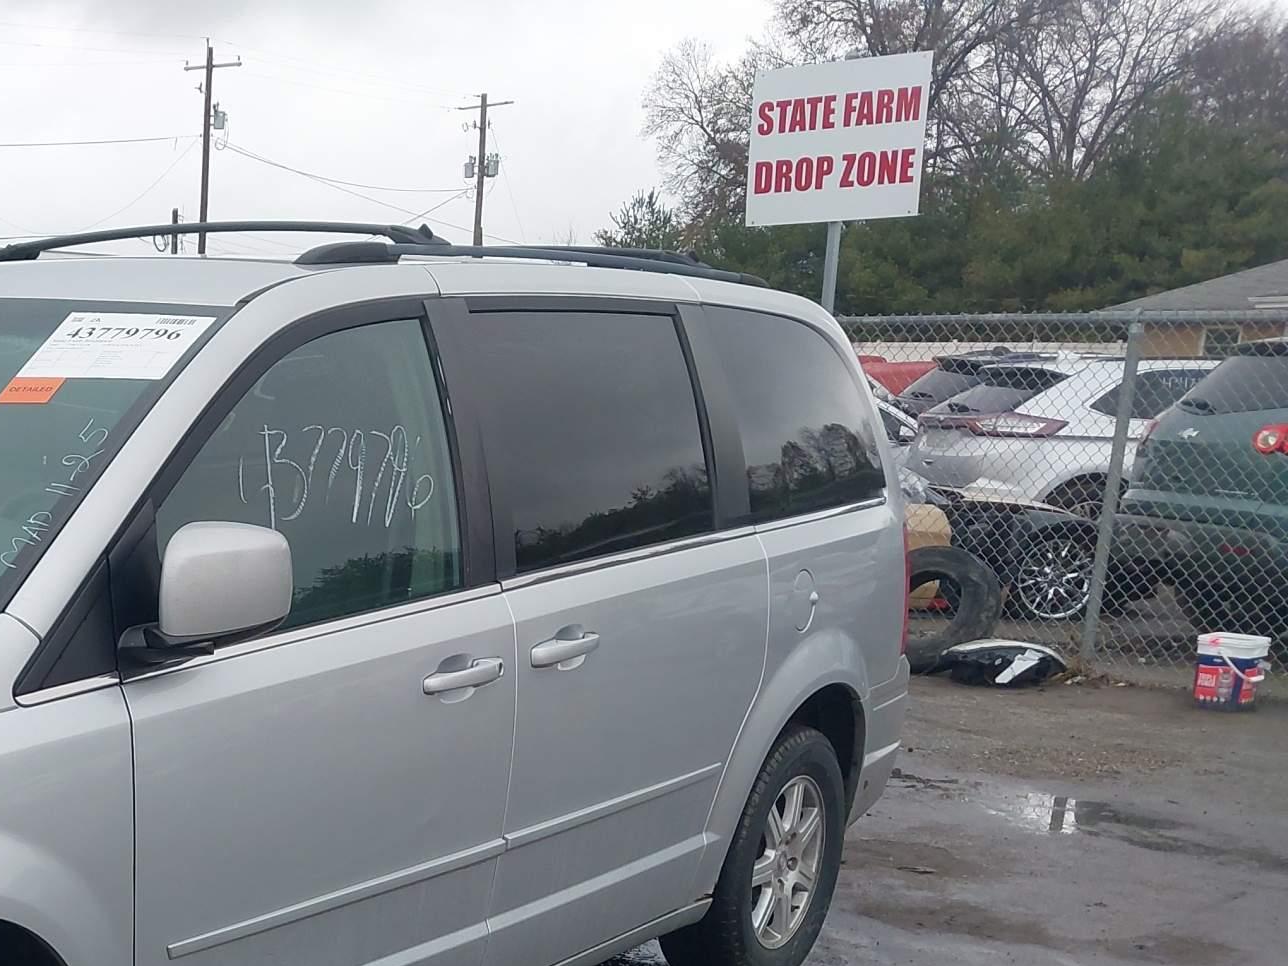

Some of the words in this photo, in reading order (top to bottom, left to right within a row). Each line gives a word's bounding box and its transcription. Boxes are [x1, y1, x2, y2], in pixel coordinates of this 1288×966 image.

[757, 95, 837, 136] STATE
[843, 85, 922, 127] FARM
[754, 156, 834, 195] DROP
[839, 148, 916, 188] ZONE
[66, 326, 182, 341] 43779796
